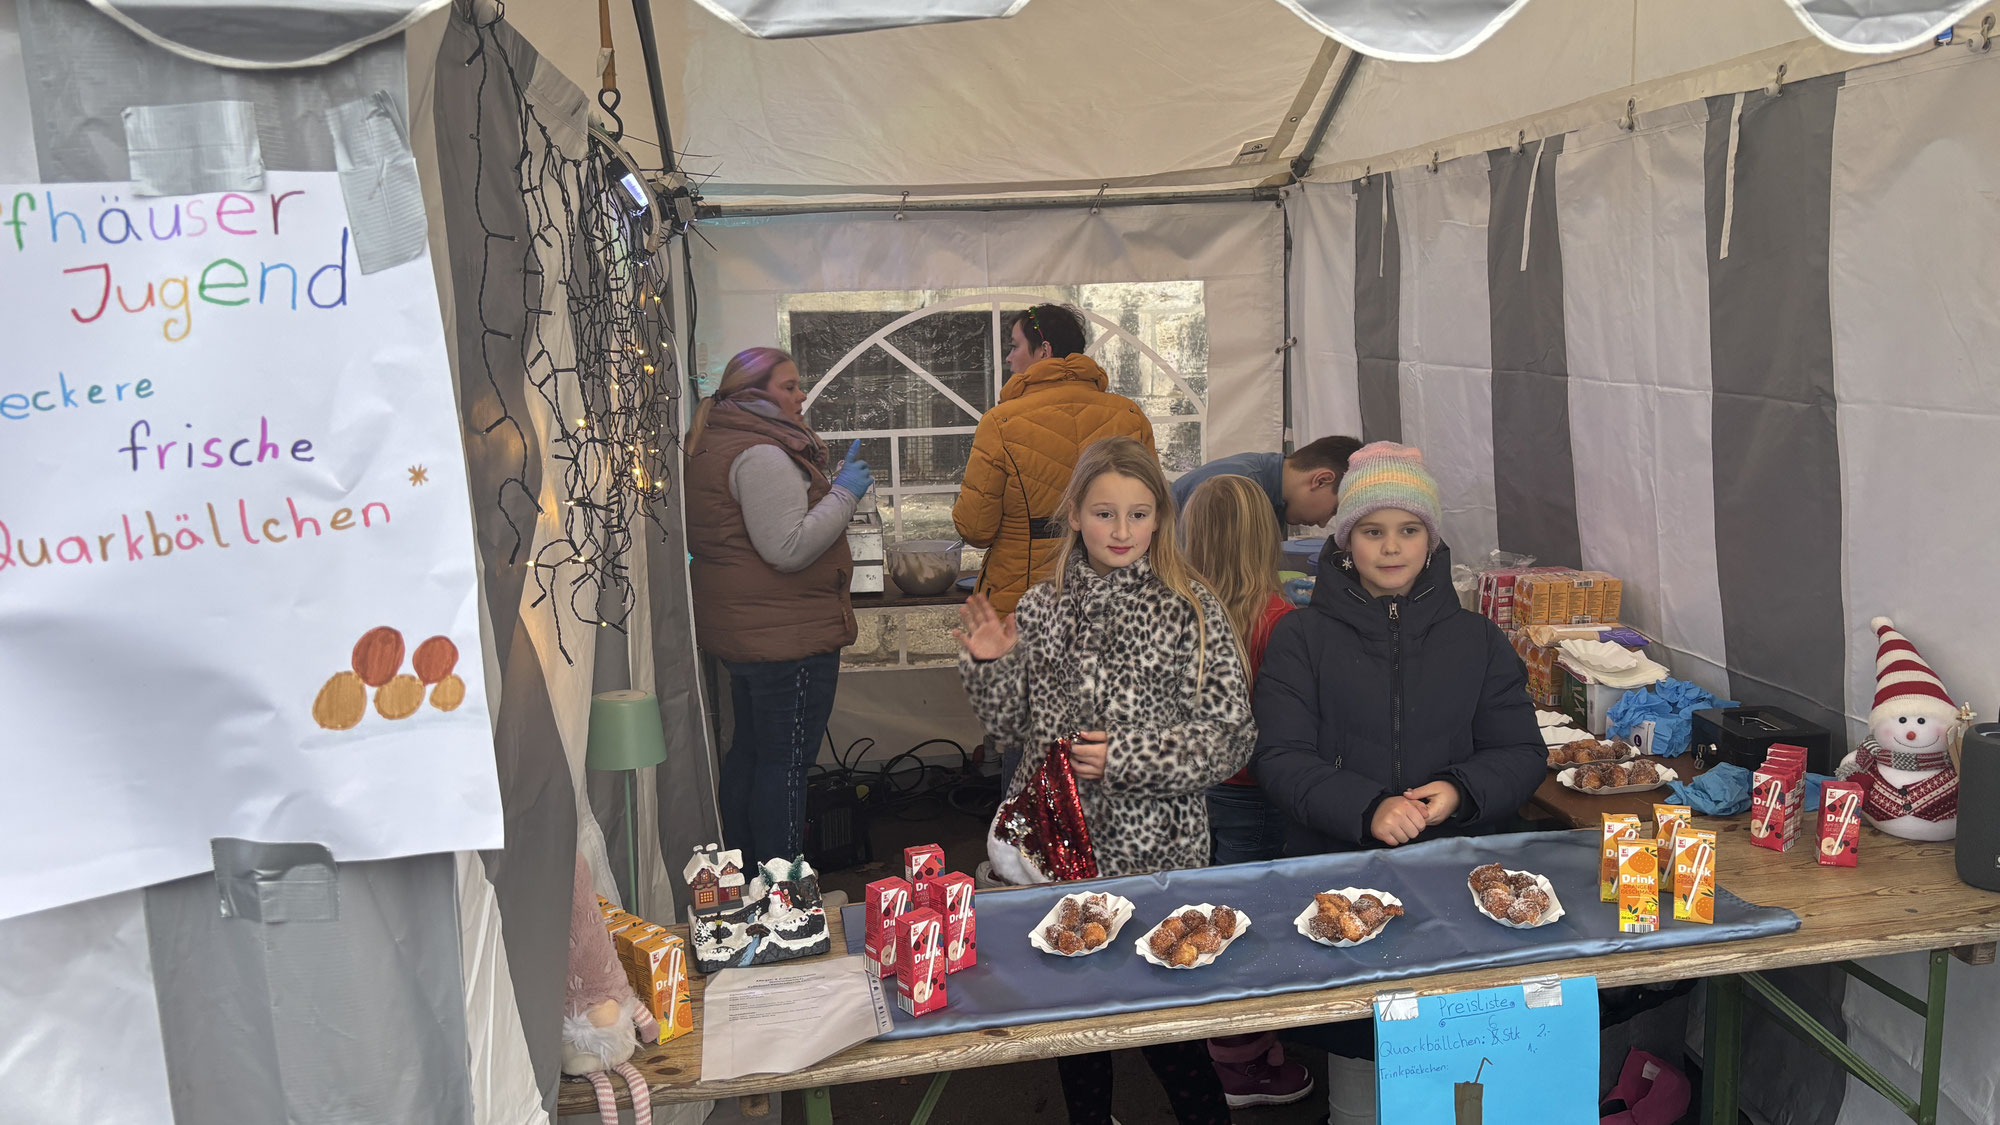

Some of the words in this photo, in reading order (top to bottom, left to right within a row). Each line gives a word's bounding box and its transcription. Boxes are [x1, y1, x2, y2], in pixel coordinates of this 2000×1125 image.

[0, 190, 305, 251] fhäuser
[63, 226, 348, 342] Jugend
[0, 371, 155, 420] eckere
[118, 416, 315, 472] frische
[1753, 797, 1782, 810] Drk
[1826, 813, 1859, 825] Drk
[1621, 874, 1656, 885] Drink
[1677, 864, 1711, 877] Drk
[949, 908, 974, 924] Drk
[914, 946, 942, 965] Drk
[655, 972, 685, 991] Drk
[1437, 992, 1508, 1017] Preisliste
[1379, 1032, 1486, 1058] Quarkbällchen:
[1503, 1026, 1521, 1042] Stk
[1380, 1063, 1449, 1081] Trinkpäckchen:
